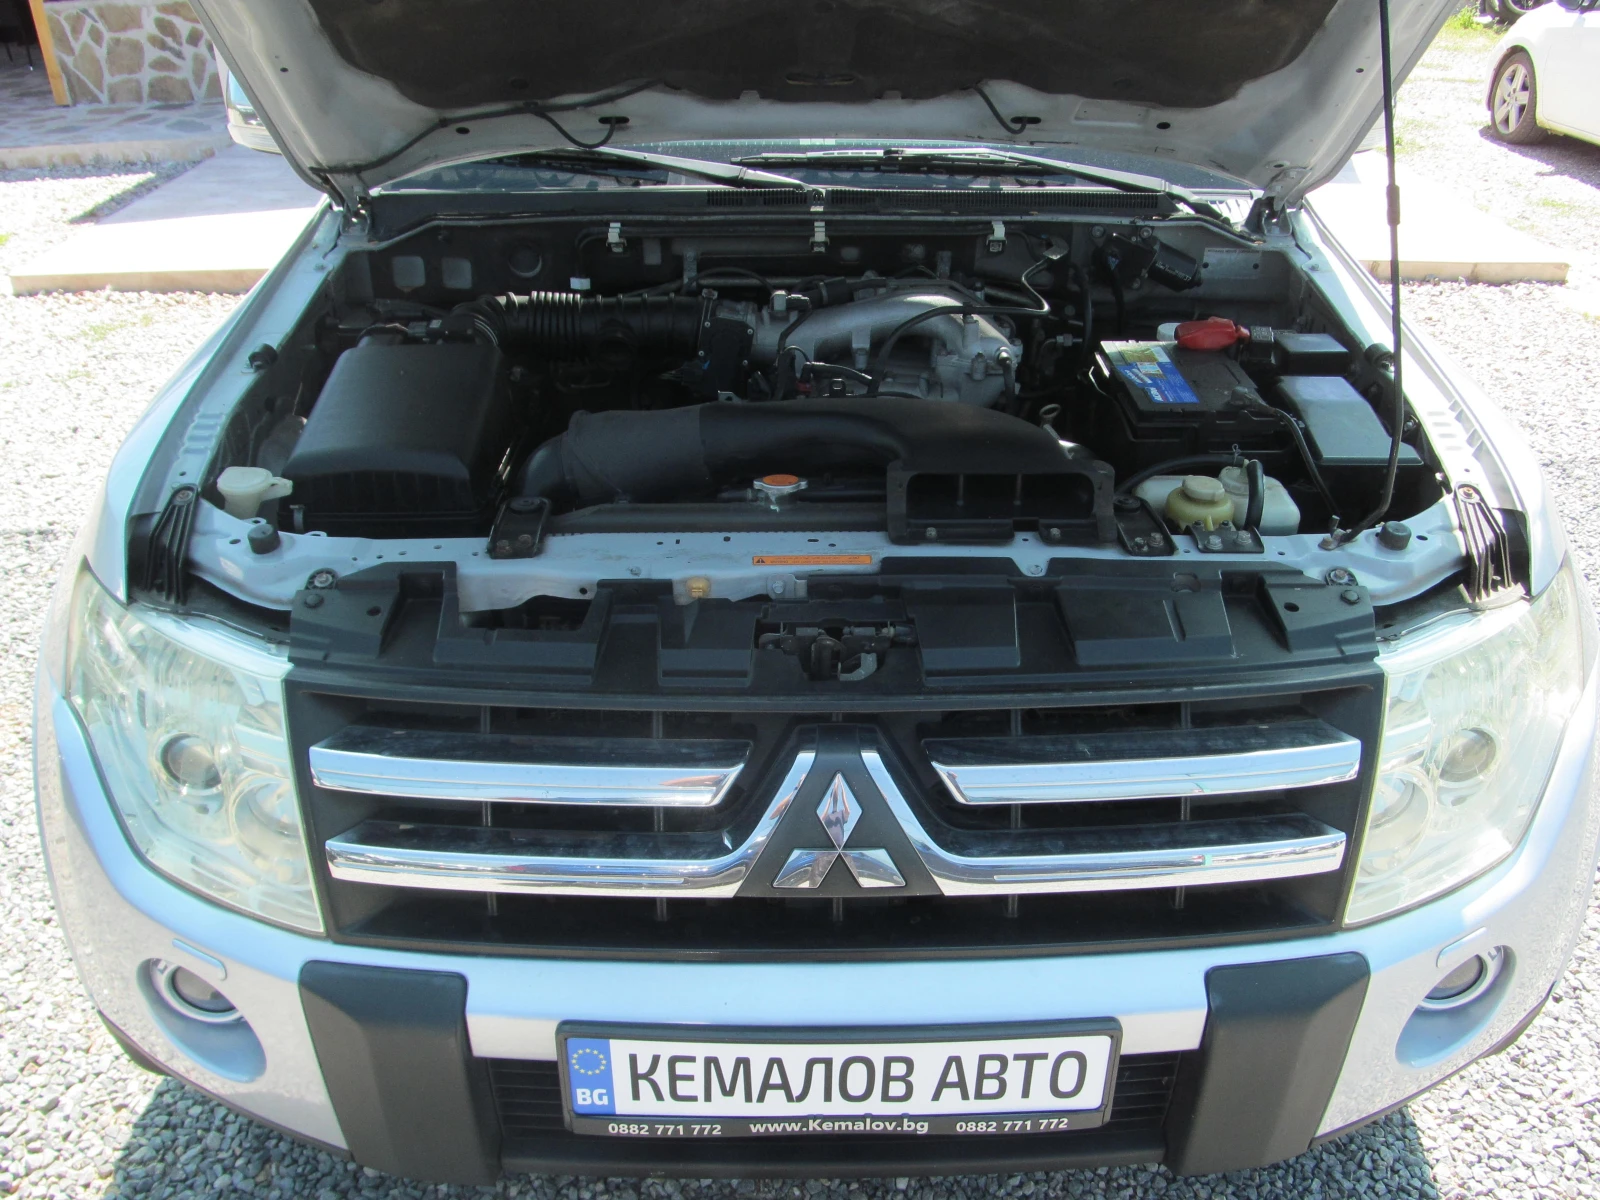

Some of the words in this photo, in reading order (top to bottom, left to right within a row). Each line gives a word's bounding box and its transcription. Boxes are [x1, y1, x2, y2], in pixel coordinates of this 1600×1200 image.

[628, 1053, 915, 1103] КЕМАЛОВ
[931, 1050, 1088, 1102] АВТО
[575, 1088, 609, 1105] BG
[608, 1123, 649, 1135] 0882
[654, 1123, 683, 1136] 771
[691, 1123, 722, 1135] 772
[749, 1117, 929, 1134] www.Kemalov.bg
[956, 1120, 997, 1133] 0882
[1003, 1119, 1032, 1131] 771
[1038, 1117, 1068, 1130] 772
